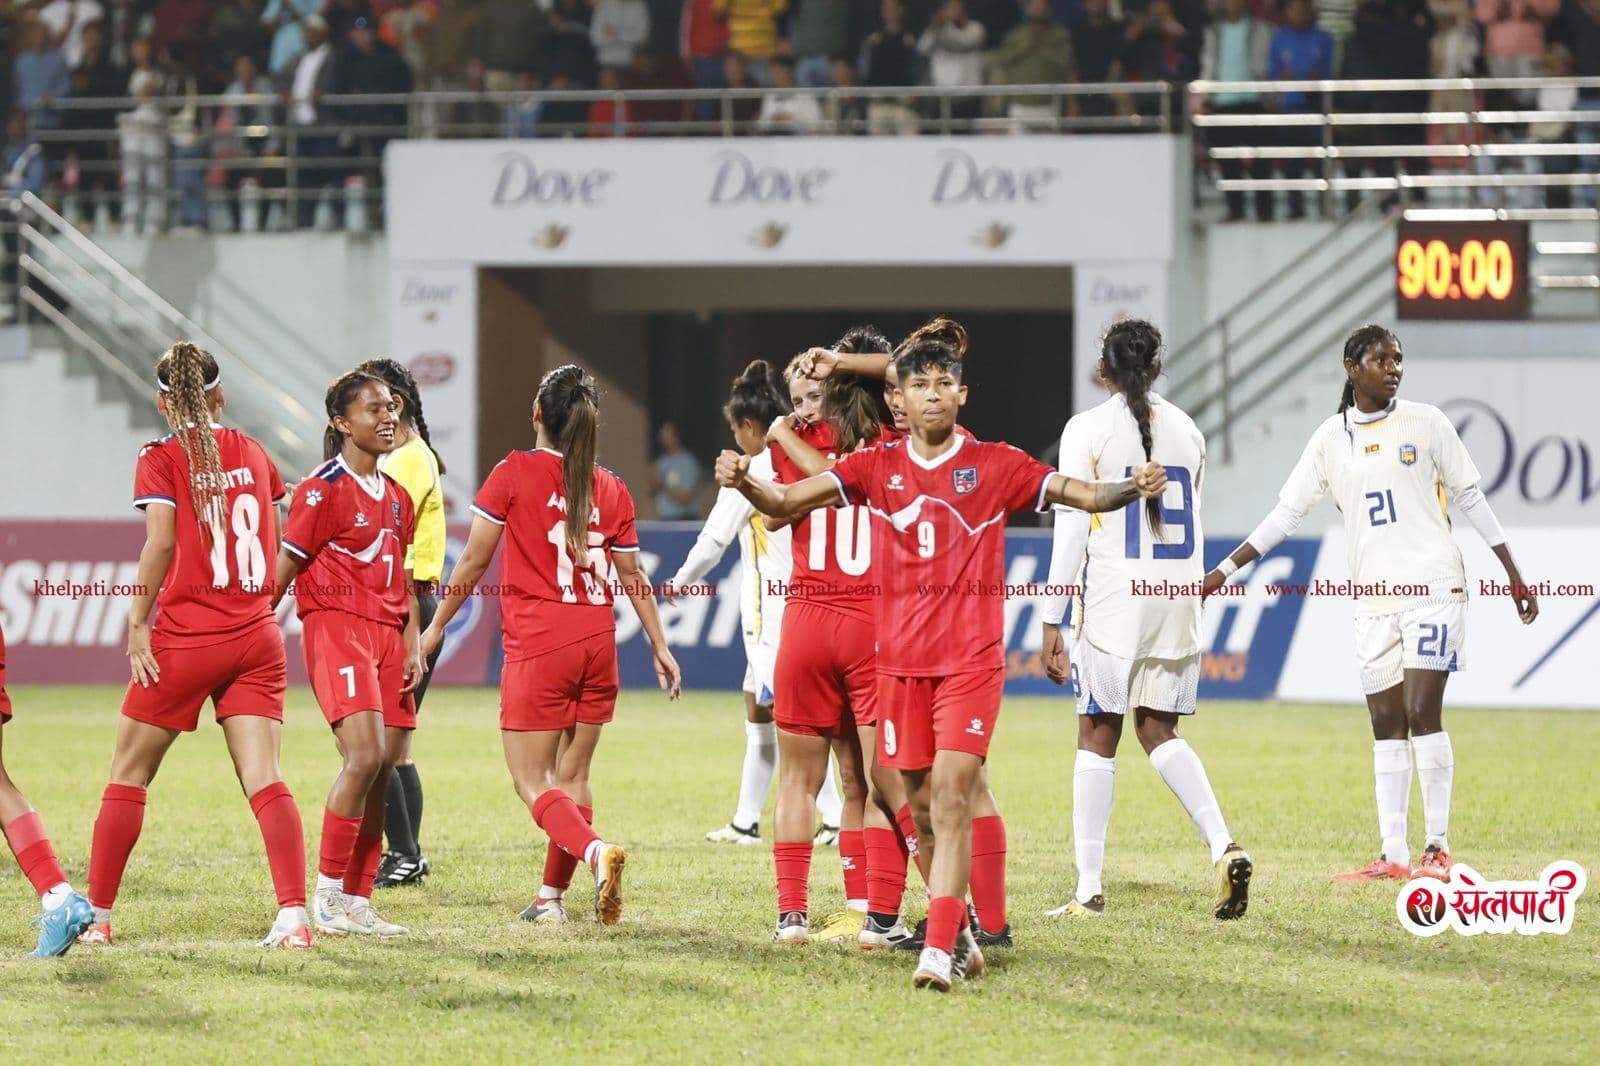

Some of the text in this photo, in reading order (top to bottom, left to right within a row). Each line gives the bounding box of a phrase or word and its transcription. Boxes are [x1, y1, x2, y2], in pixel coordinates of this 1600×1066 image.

[492, 150, 616, 207] Dove
[708, 150, 834, 206] Dove
[931, 149, 1062, 207] Dove
[1396, 239, 1513, 300] 90:00
[1125, 466, 1195, 560] 19
[1365, 489, 1397, 527] 21
[808, 504, 872, 577] 10
[917, 521, 935, 558] 9
[381, 554, 394, 588] 7
[1417, 623, 1448, 658] 21
[884, 719, 897, 756] 9
